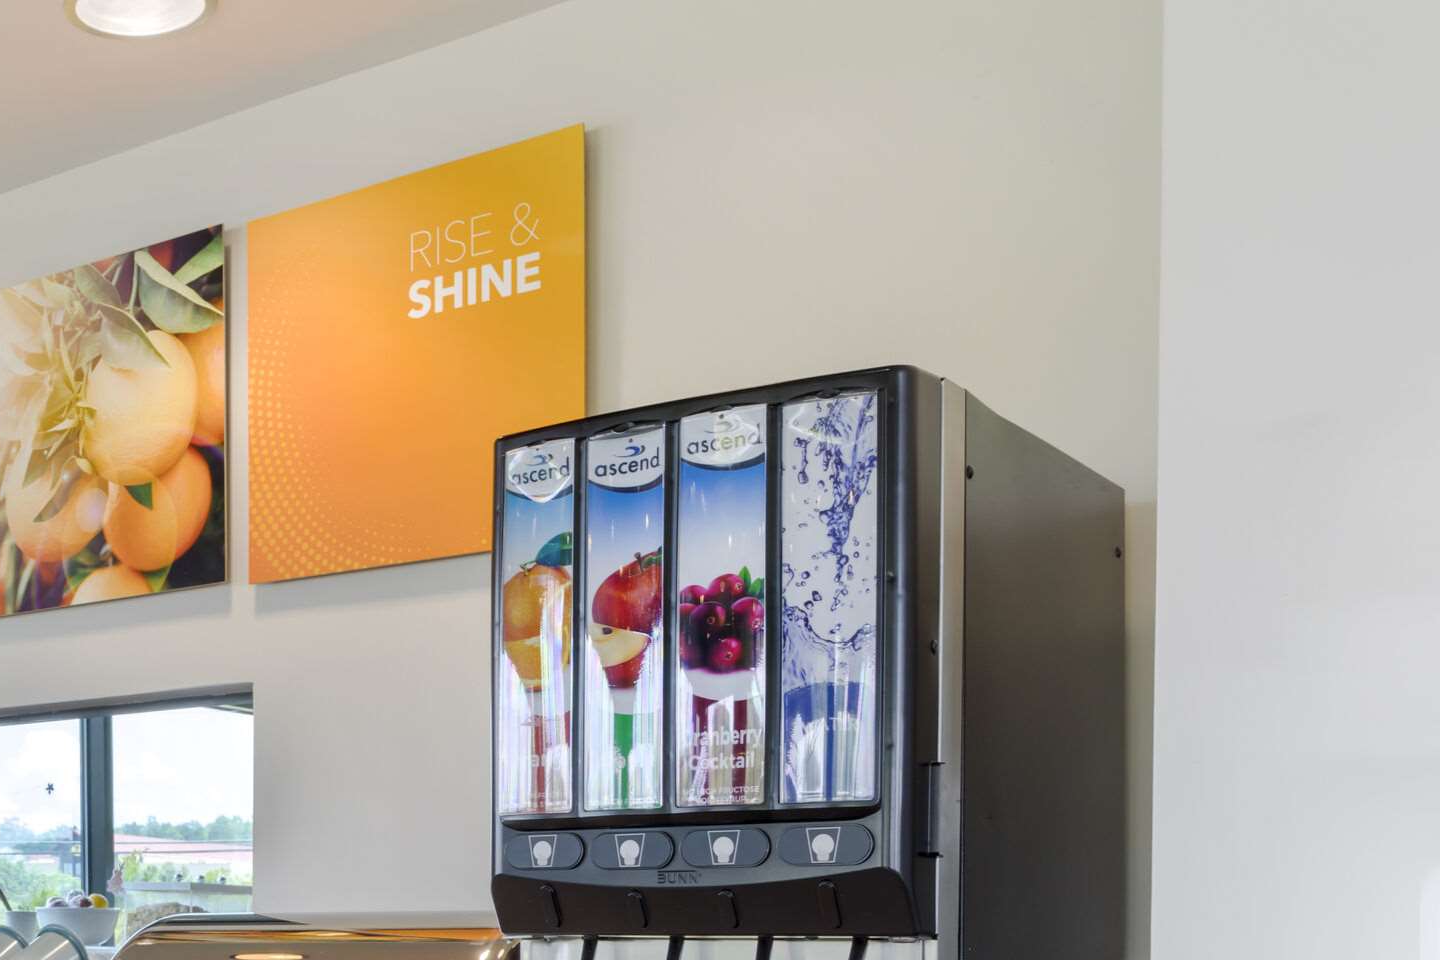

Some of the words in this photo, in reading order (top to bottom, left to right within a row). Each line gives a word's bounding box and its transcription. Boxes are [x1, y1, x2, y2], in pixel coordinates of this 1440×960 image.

[410, 212, 494, 272] RISE
[510, 202, 540, 246] &
[407, 251, 542, 319] SHINE
[686, 422, 762, 455] ascend
[511, 456, 570, 484] ascend
[594, 446, 661, 477] ascend
[684, 726, 763, 749] ranberry
[688, 750, 756, 770] Cocktail
